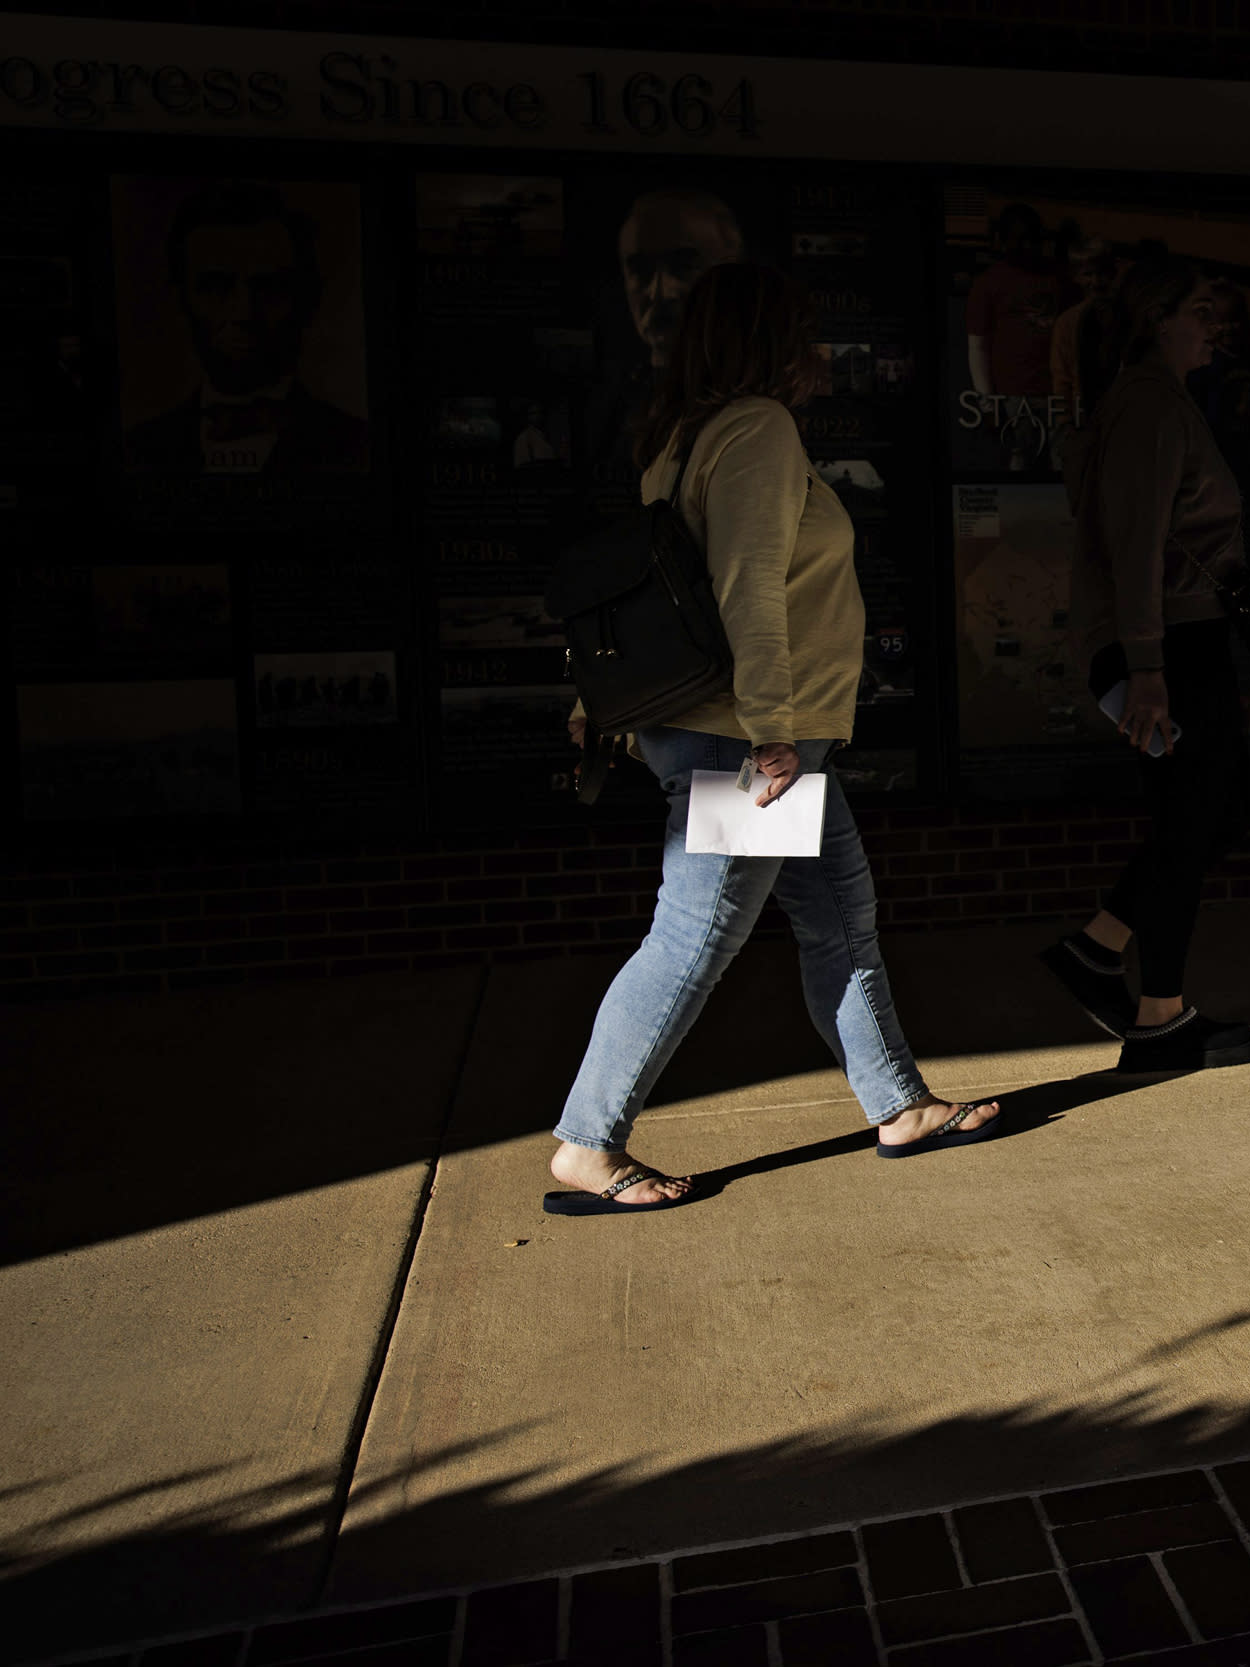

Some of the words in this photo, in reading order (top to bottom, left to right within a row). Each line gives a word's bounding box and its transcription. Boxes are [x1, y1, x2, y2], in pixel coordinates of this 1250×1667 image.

[319, 51, 542, 127] Since
[577, 72, 761, 138] 1664
[880, 637, 904, 653] 95
